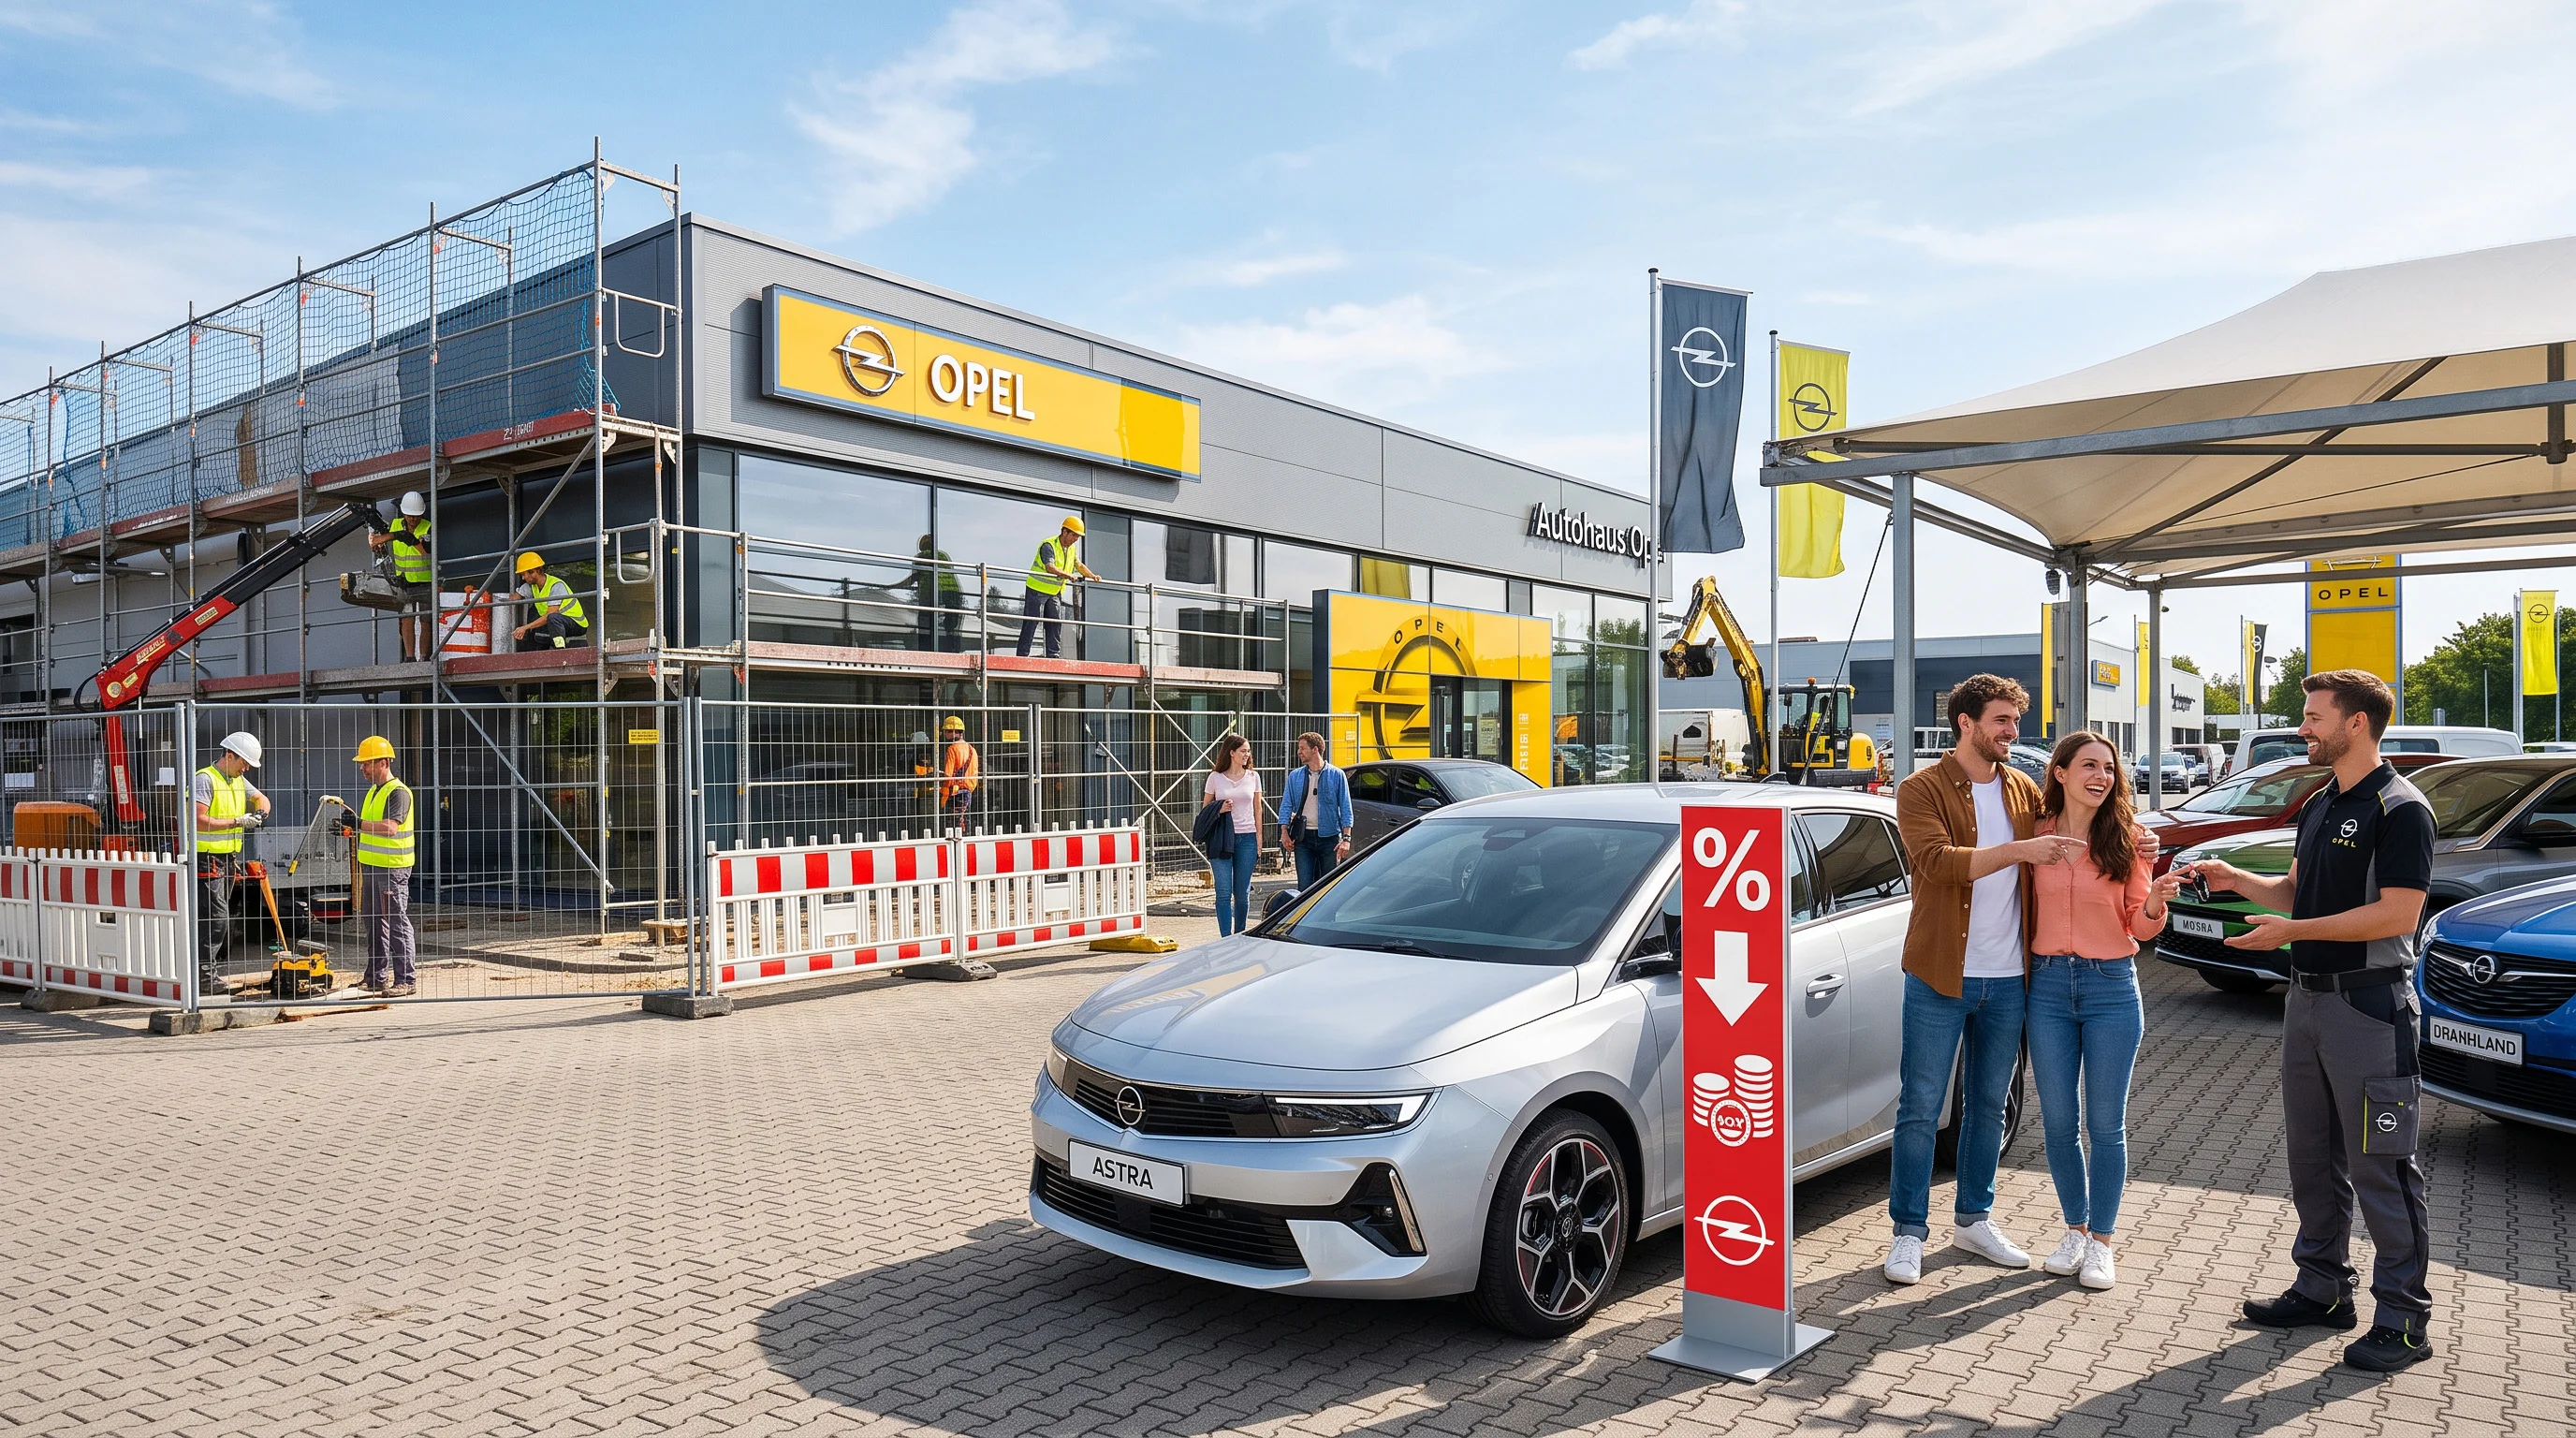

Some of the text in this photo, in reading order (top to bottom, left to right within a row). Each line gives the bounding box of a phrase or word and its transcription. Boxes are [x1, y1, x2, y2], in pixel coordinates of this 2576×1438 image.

[927, 353, 1036, 420] OPEL
[1530, 502, 1667, 569] Autohaus Op
[2319, 587, 2389, 600] OPEL
[1394, 618, 1461, 653] OPEL
[2332, 837, 2357, 848] OPEL
[2434, 1024, 2516, 1056] DRANHLAND
[1091, 1156, 1154, 1190] ASTRA
